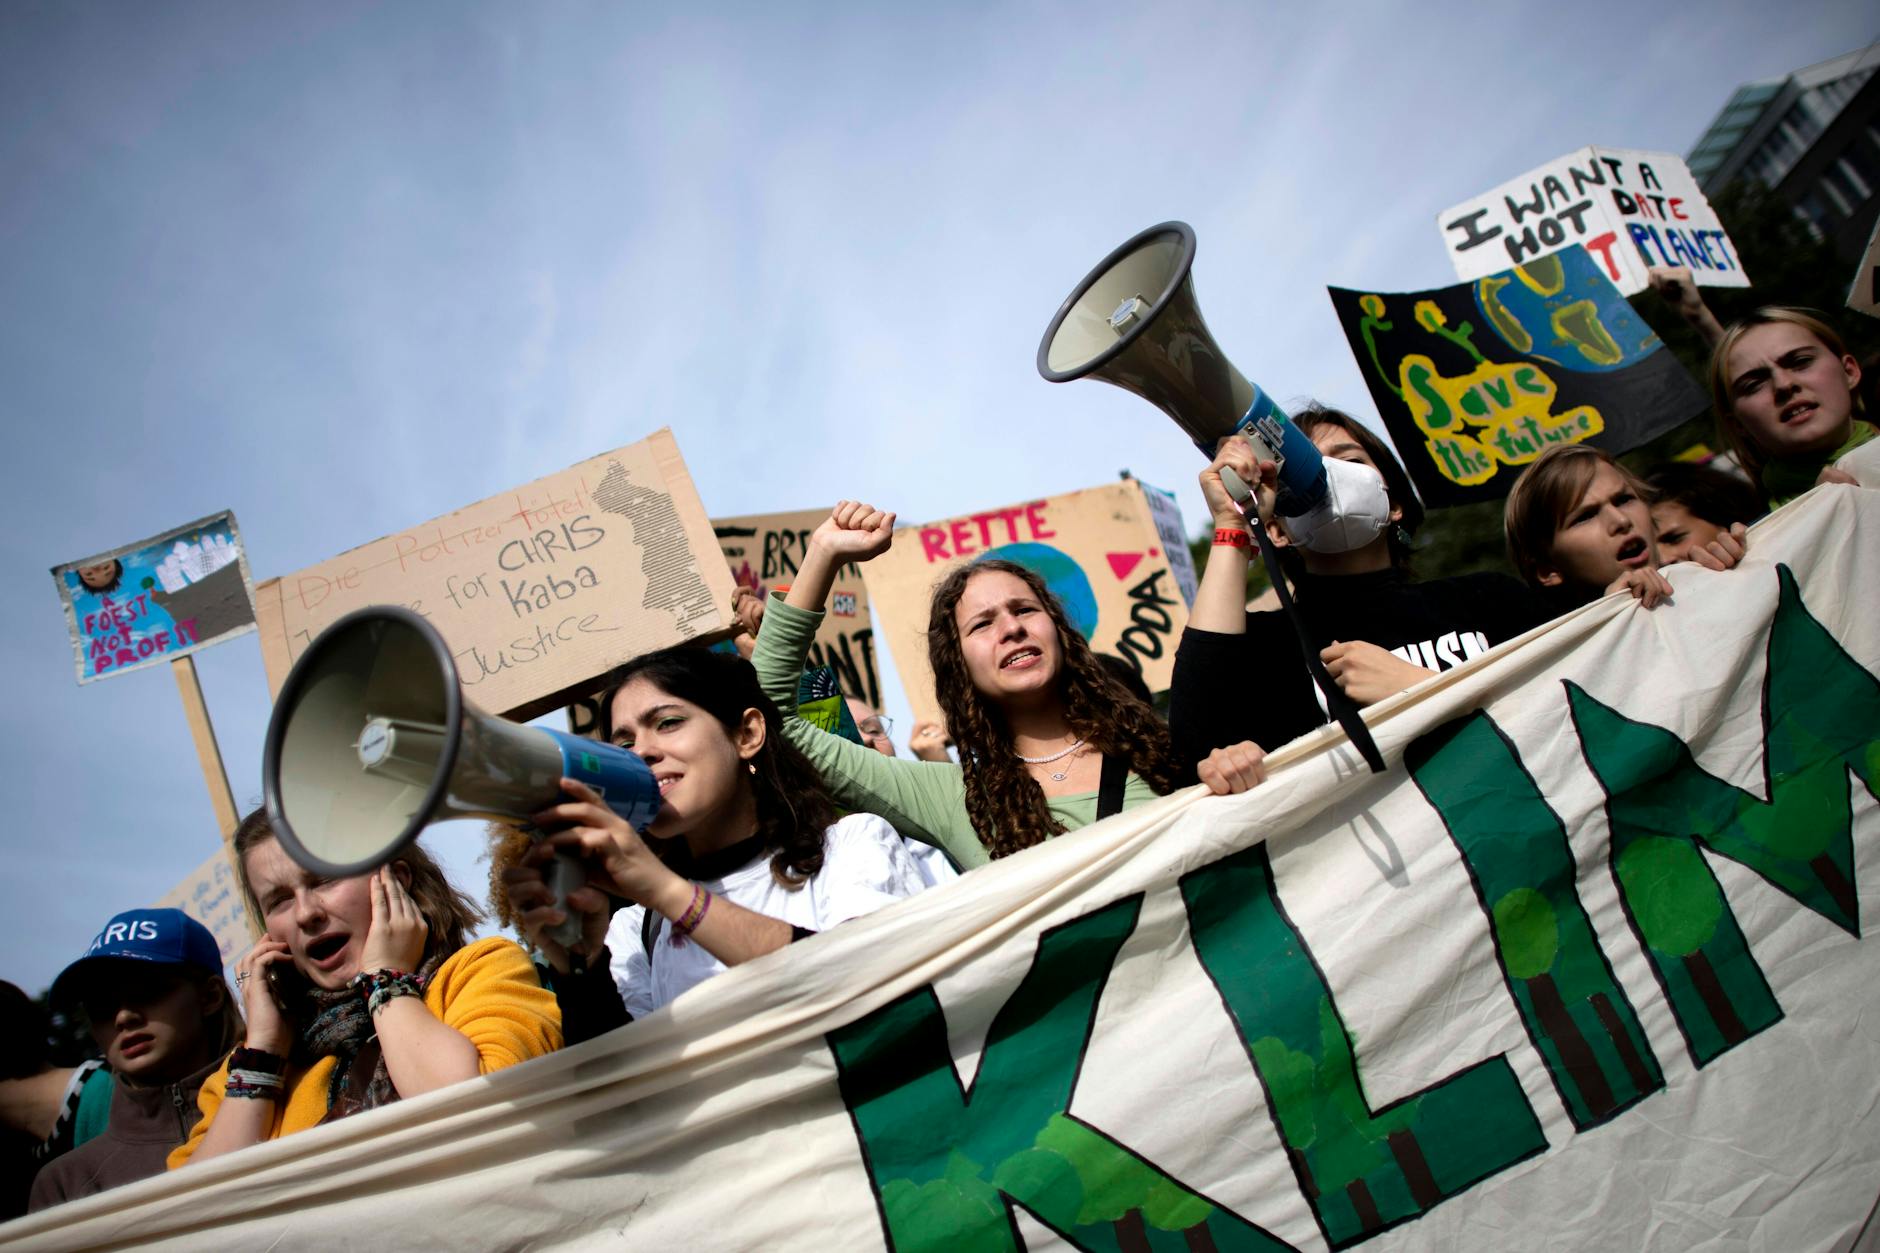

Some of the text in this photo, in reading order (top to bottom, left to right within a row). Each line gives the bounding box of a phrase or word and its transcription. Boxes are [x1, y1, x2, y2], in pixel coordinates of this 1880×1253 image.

[1447, 157, 1662, 251] I WANT A
[1504, 189, 1689, 264] HOT DATE
[1625, 223, 1736, 271] PLANET
[1408, 364, 1546, 429] Save
[1435, 414, 1590, 479] the future
[498, 515, 605, 571] CHRIS
[919, 500, 1056, 563] RETTE
[84, 594, 148, 635] FOEST
[445, 573, 489, 610] for
[500, 565, 600, 618] Kaba
[90, 621, 133, 658] NOT
[94, 617, 199, 674] PROFIT
[454, 613, 619, 685] Justice
[91, 920, 158, 952] ARIS
